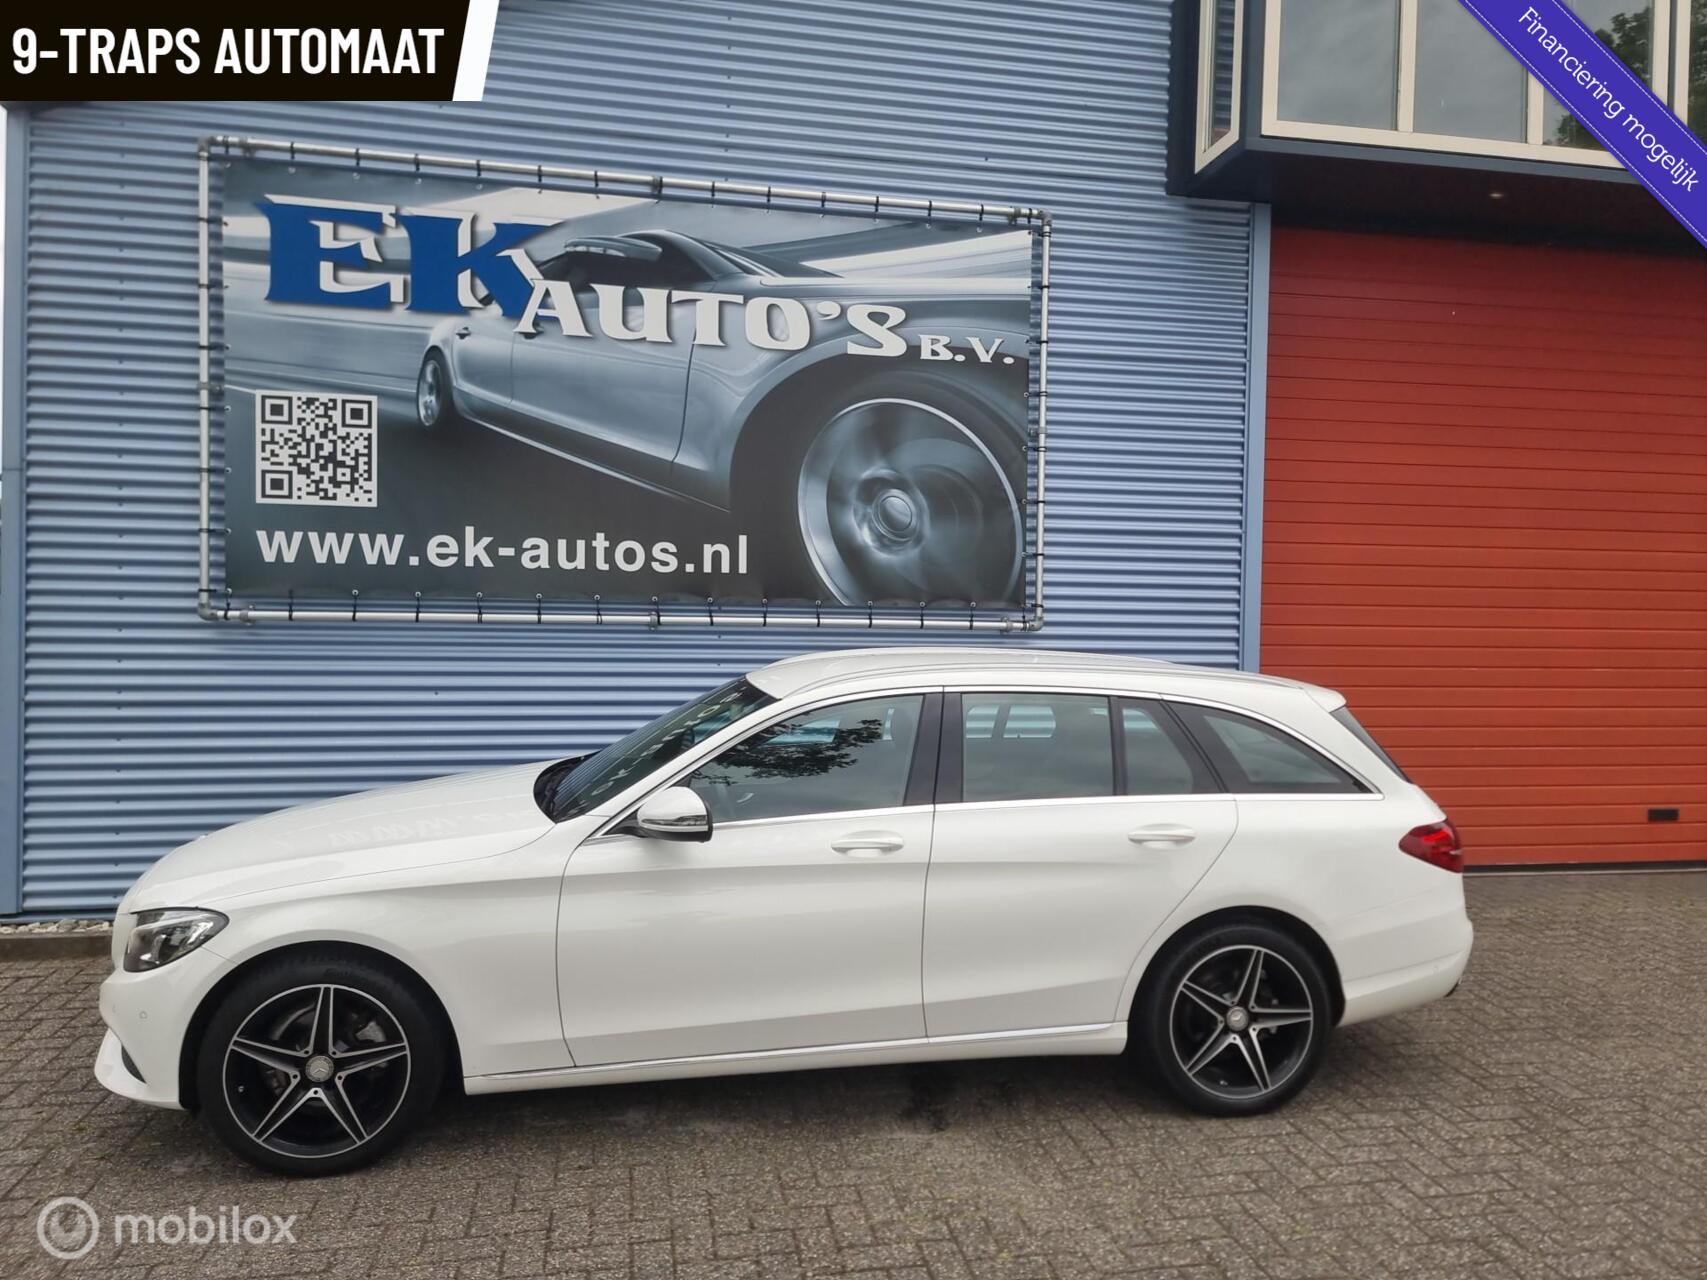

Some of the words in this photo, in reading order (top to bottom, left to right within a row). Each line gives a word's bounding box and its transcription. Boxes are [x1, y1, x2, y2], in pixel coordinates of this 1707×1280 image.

[261, 194, 566, 320] EK
[513, 277, 908, 358] AUTO'S
[919, 333, 1016, 365] B.V.
[256, 525, 749, 575] www.ek-autos.nl
